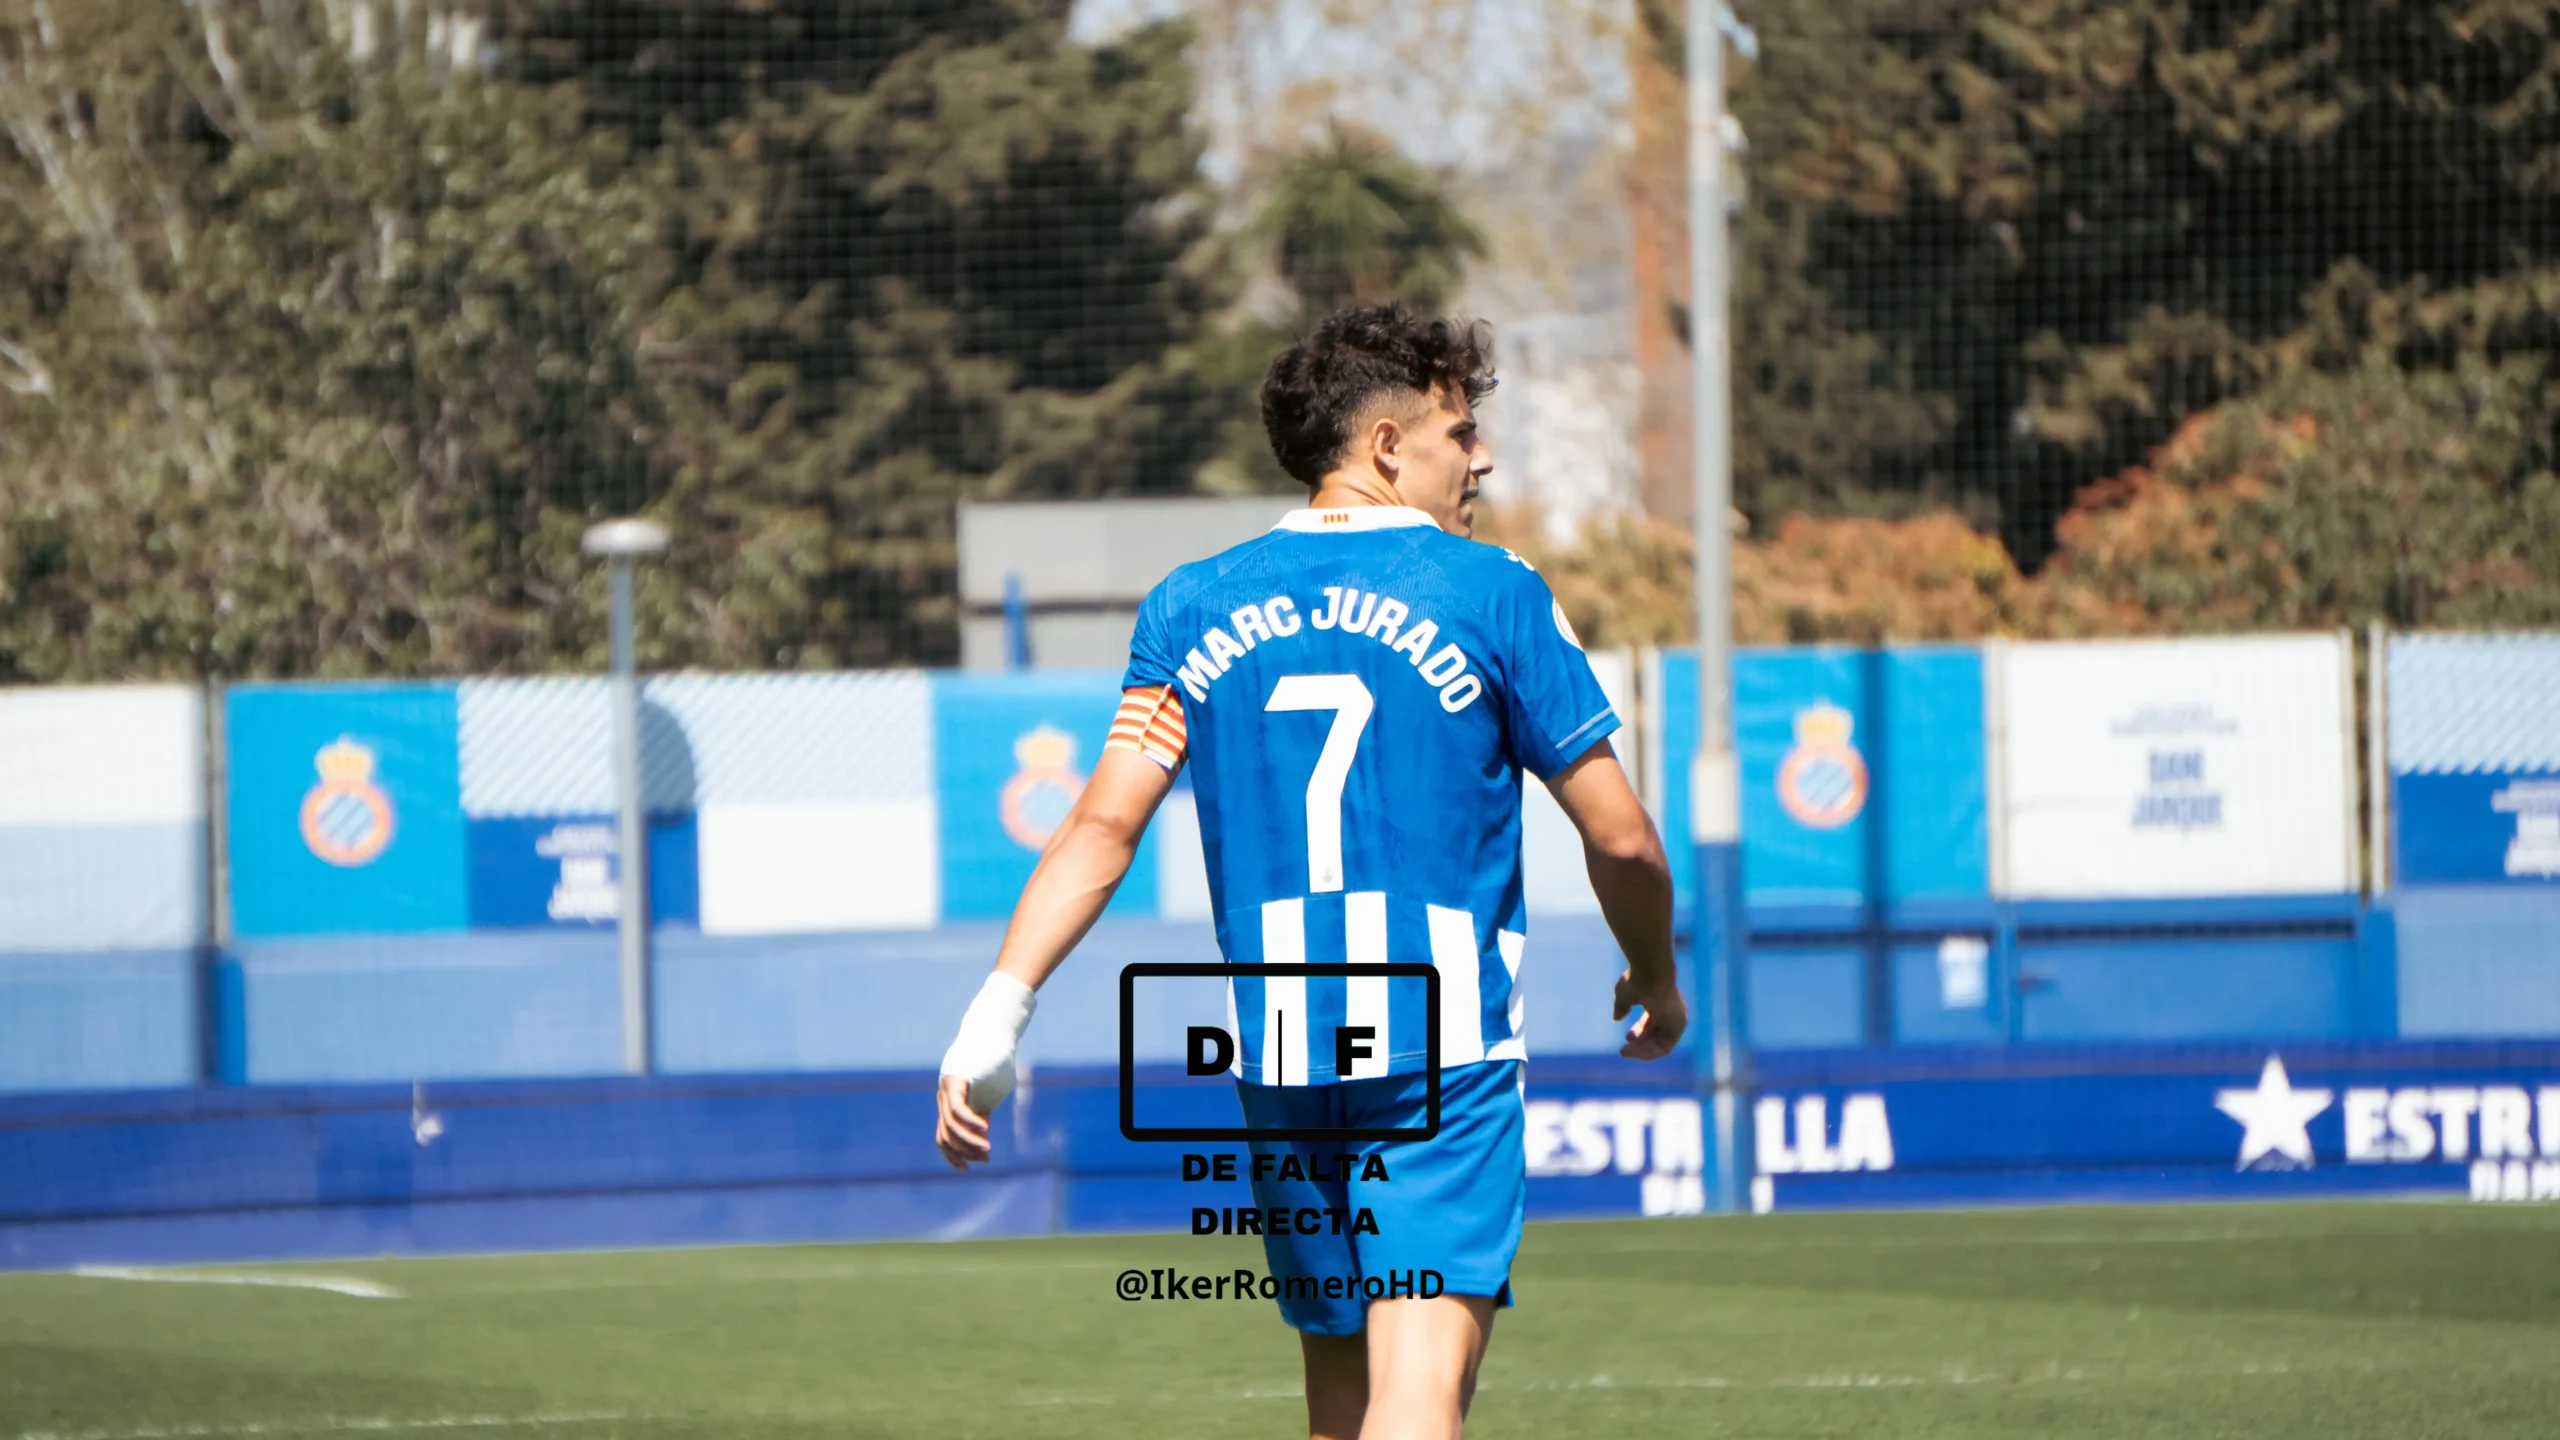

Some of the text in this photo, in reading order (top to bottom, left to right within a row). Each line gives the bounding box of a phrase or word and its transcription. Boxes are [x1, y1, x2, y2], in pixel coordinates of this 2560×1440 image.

[1176, 587, 1482, 713] MARC JURADO
[1264, 674, 1374, 893] 7
[1525, 1095, 1894, 1176] ESTRLLA
